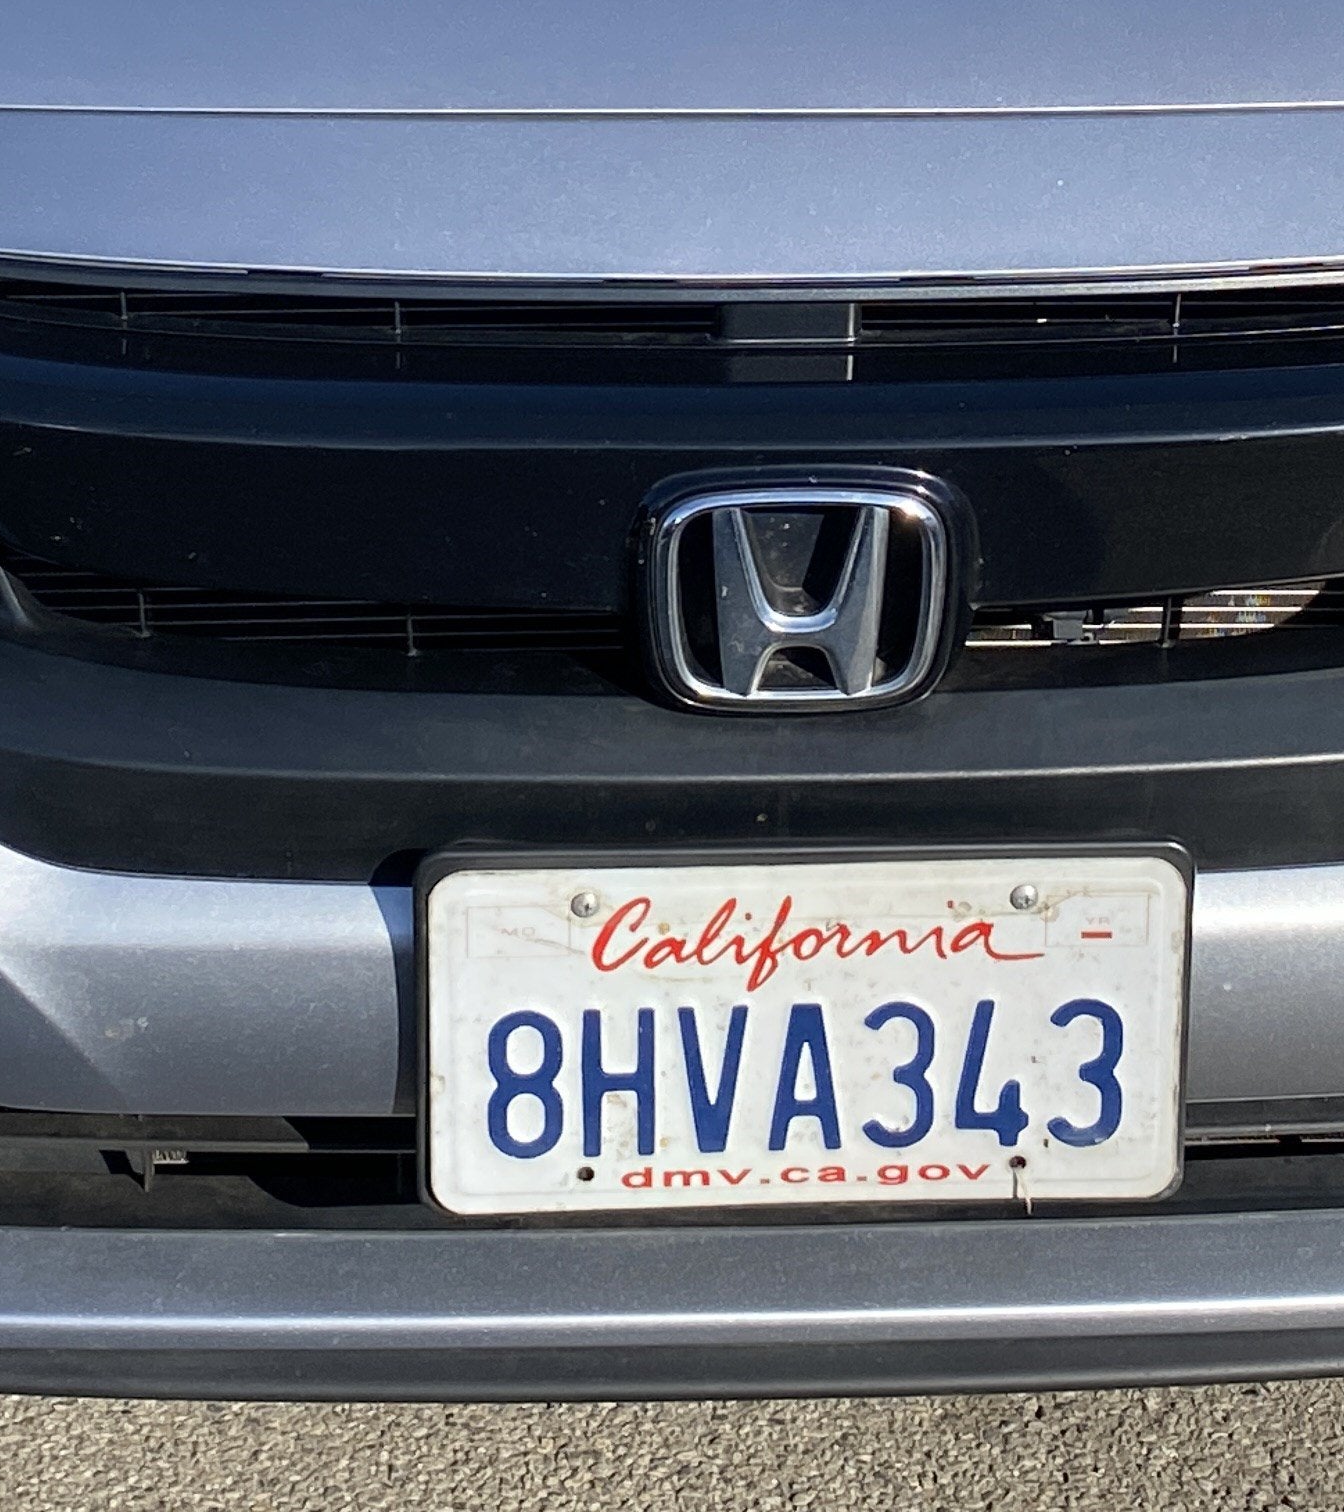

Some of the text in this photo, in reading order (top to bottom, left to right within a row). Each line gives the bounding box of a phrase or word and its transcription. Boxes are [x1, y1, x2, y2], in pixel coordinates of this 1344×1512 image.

[591, 896, 1044, 992] California
[487, 999, 1124, 1159] 8HVA343
[622, 1163, 990, 1189] dmv.ca.gov
